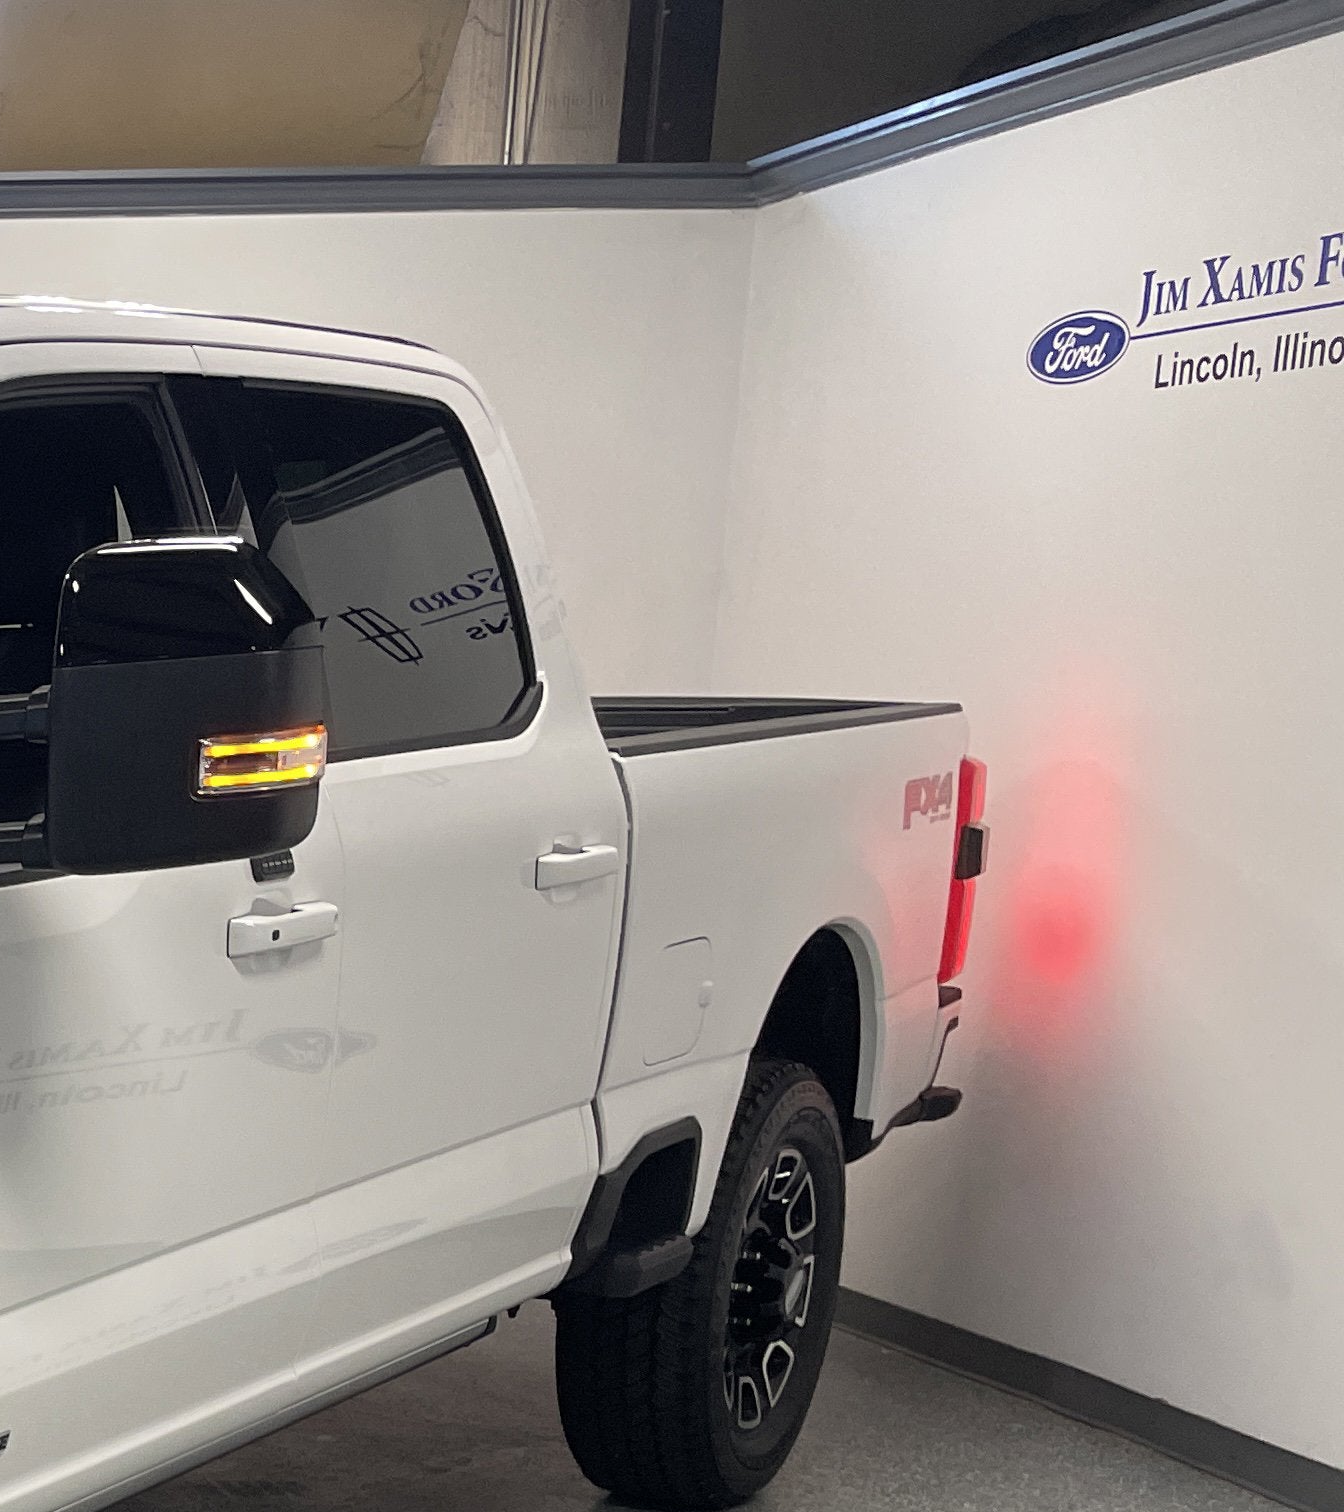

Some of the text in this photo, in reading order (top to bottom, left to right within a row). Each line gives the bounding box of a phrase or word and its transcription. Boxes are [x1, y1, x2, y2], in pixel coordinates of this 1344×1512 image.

[1314, 232, 1344, 287] F
[1044, 325, 1110, 373] Ford
[1154, 342, 1262, 388] Lincoln,
